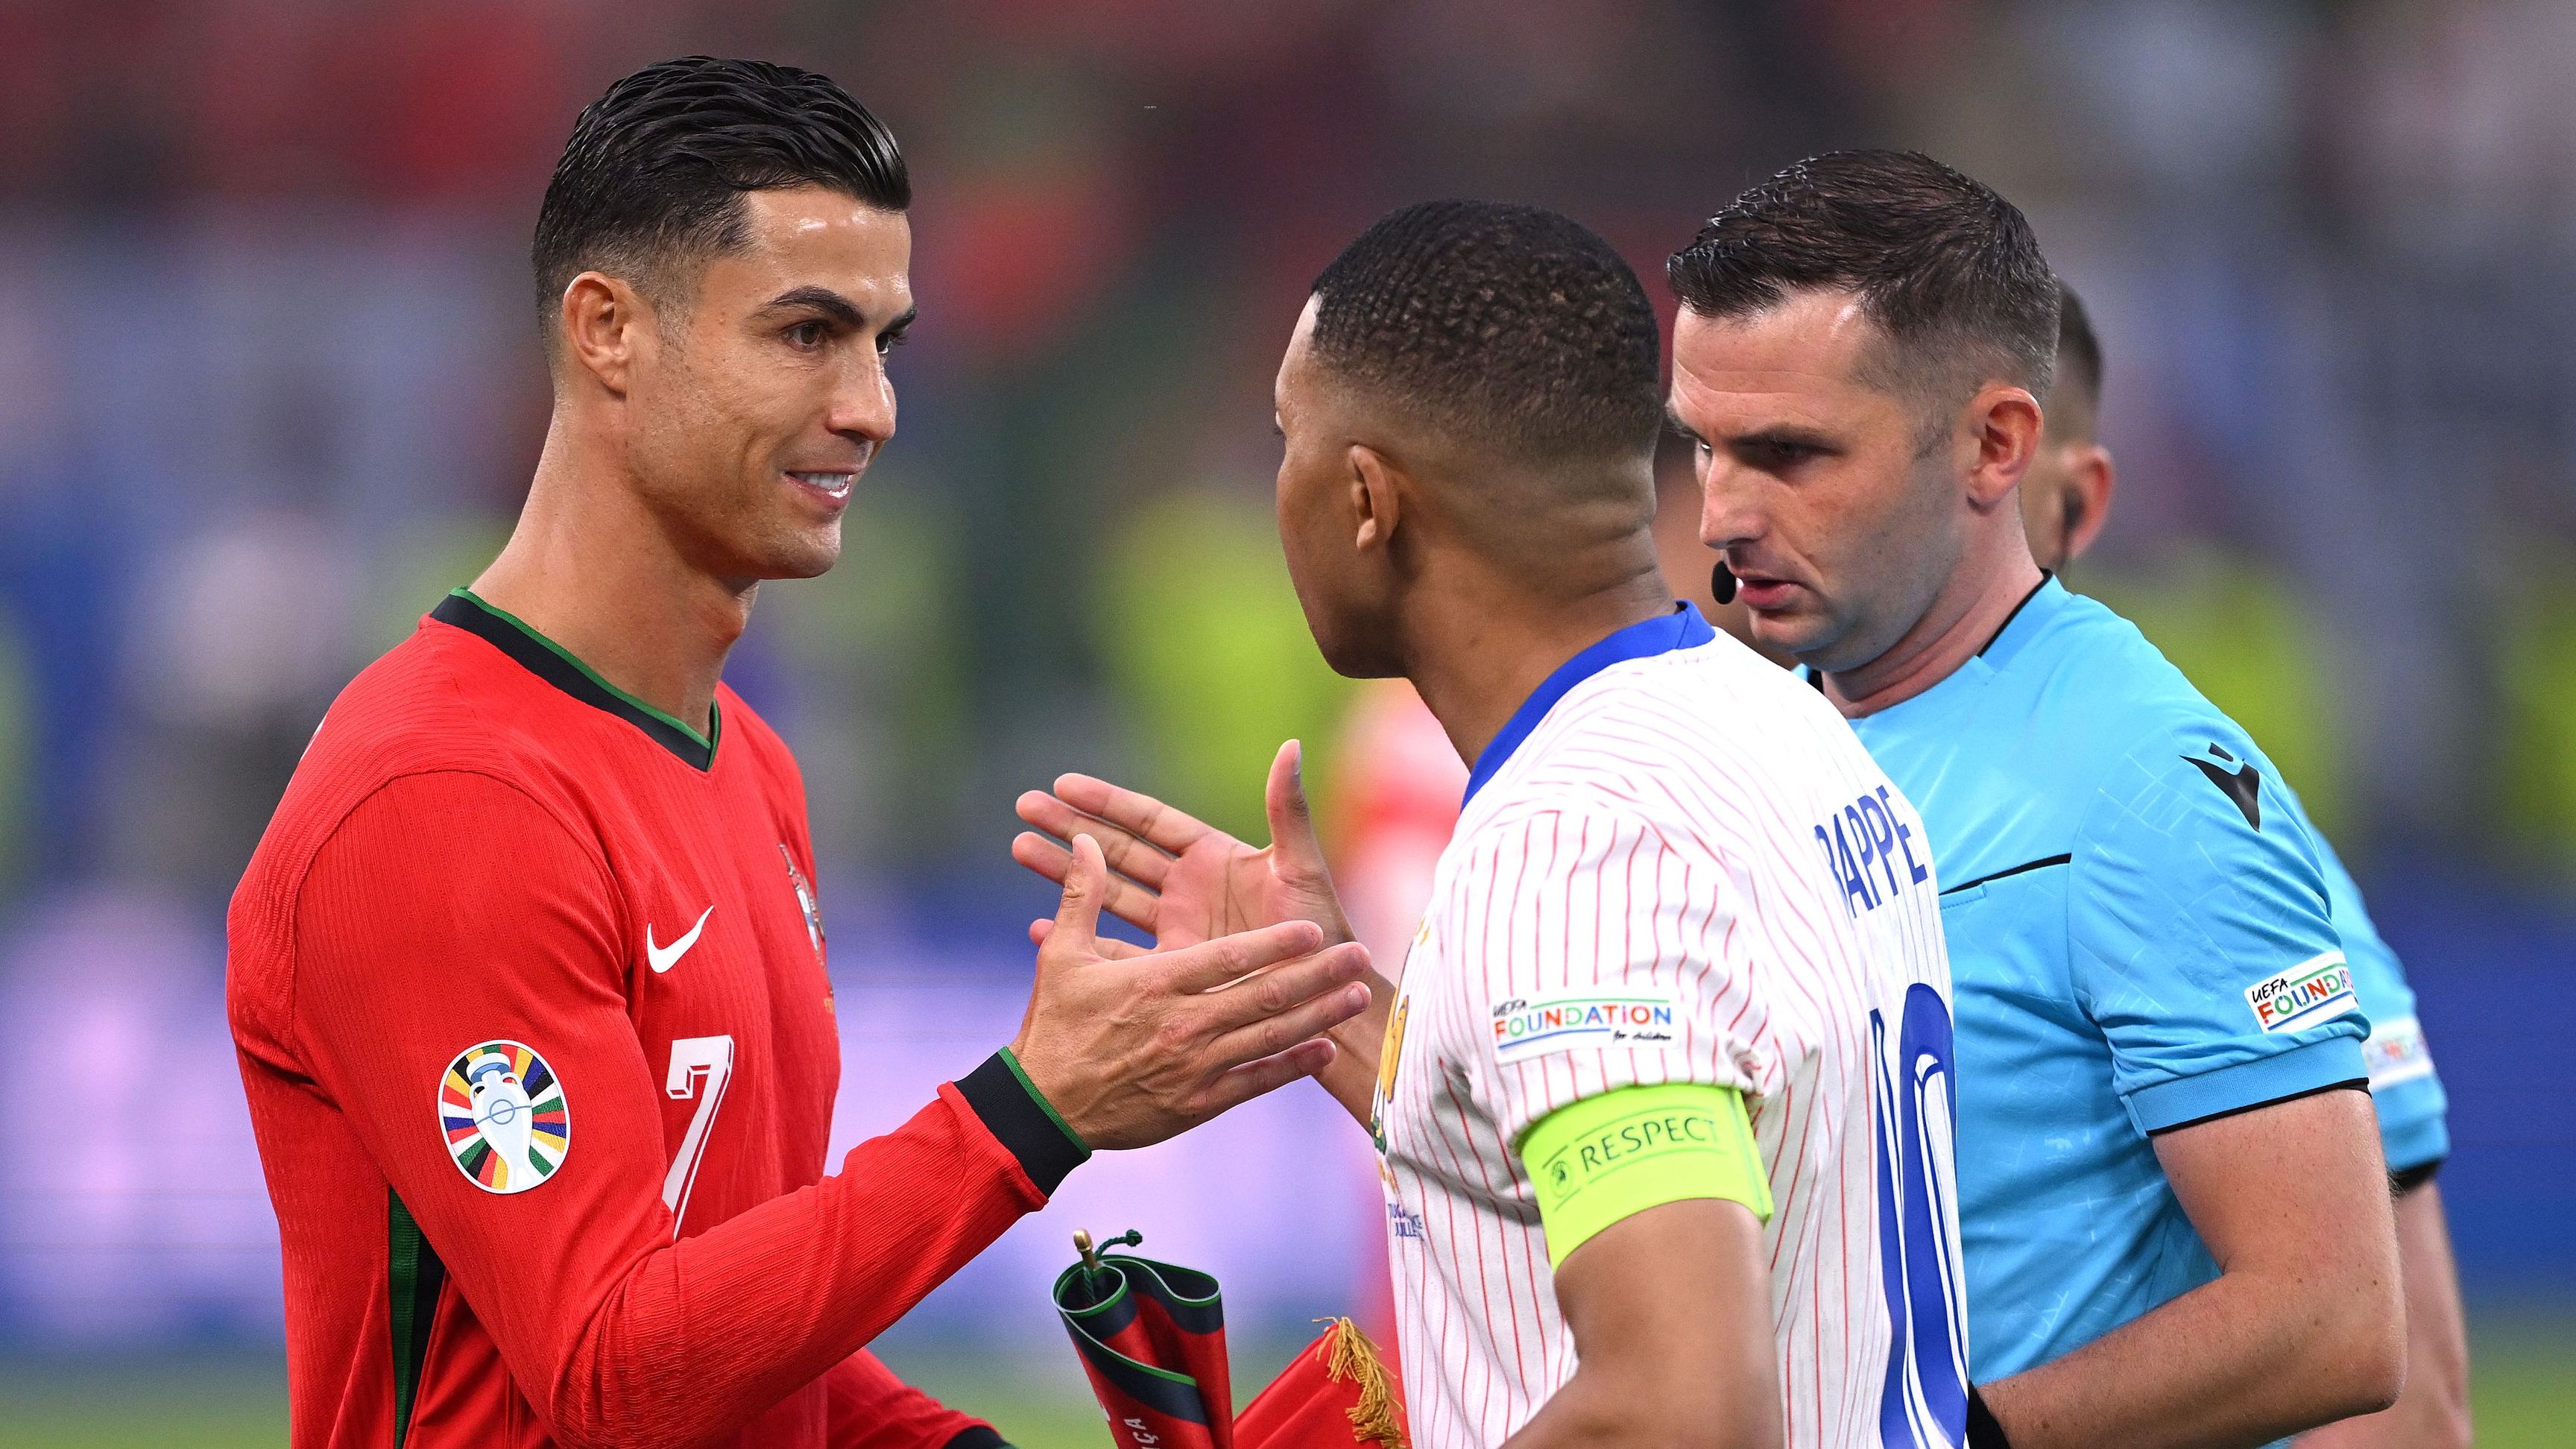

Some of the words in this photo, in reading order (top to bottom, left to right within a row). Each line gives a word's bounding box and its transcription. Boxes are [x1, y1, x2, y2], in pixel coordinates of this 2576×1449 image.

[2252, 978, 2288, 1003] UEFA
[1494, 1004, 1671, 1041] FOUNDATION
[662, 1035, 734, 1241] 7
[1580, 1117, 1717, 1172] RESPECT
[1869, 982, 1969, 1449] 10
